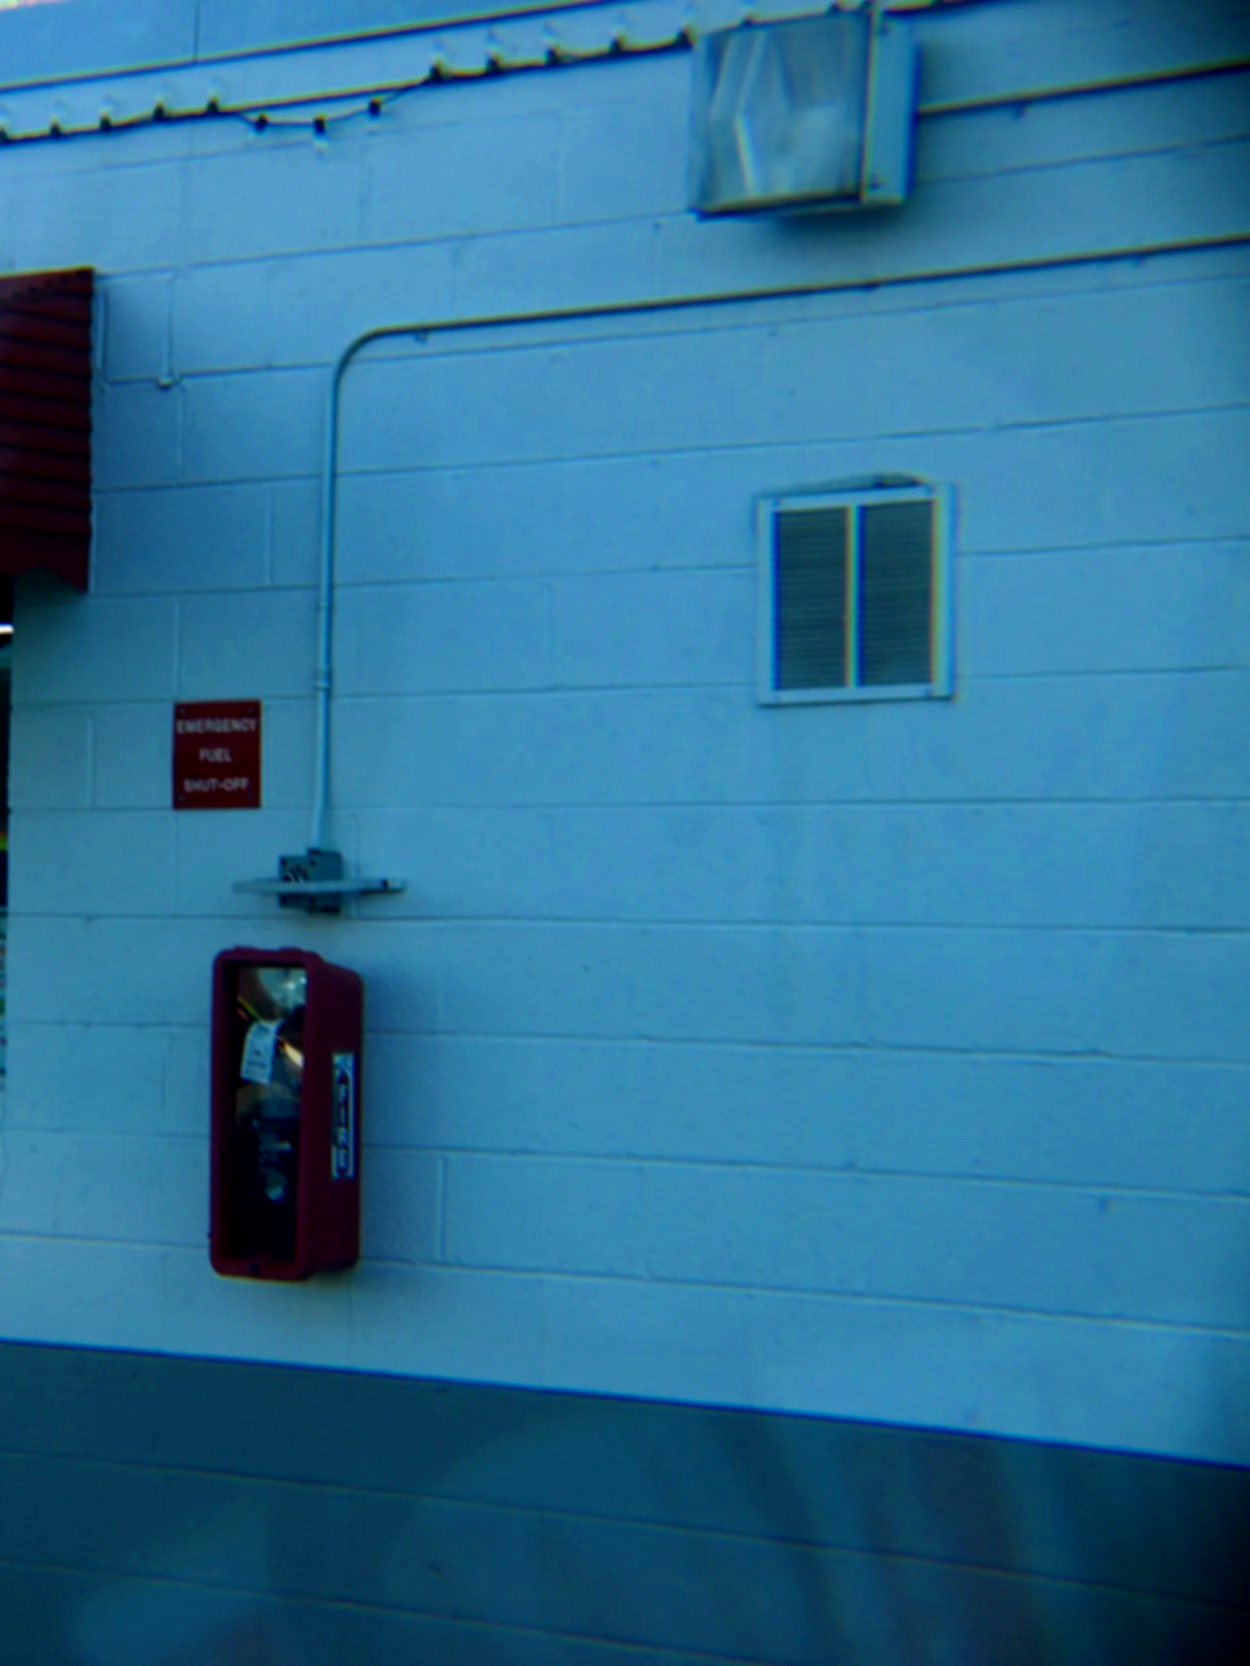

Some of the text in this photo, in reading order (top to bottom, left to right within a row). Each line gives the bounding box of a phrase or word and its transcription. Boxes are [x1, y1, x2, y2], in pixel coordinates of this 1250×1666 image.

[177, 719, 255, 734] EMERGENCY
[200, 748, 232, 763] FUEL
[184, 777, 248, 793] SHUT-OFF
